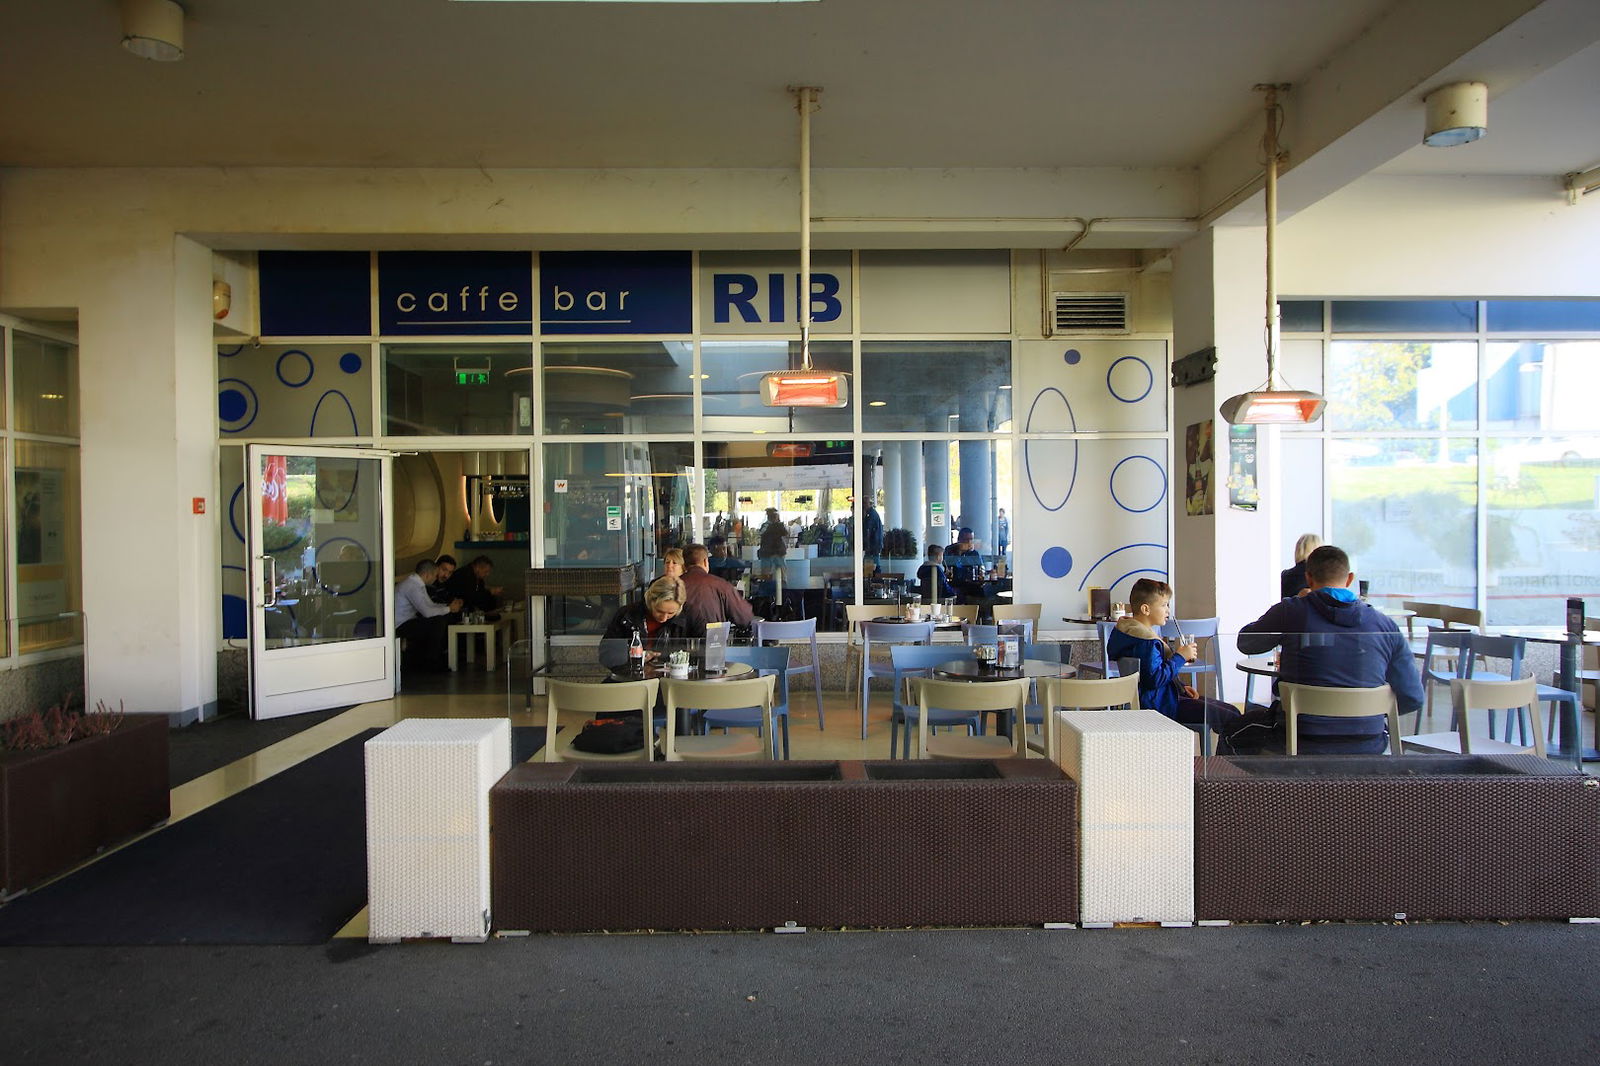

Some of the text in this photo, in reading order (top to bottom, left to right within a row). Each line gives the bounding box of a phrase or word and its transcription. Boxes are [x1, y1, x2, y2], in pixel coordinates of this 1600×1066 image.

[396, 273, 842, 323] caffe bar RIB
